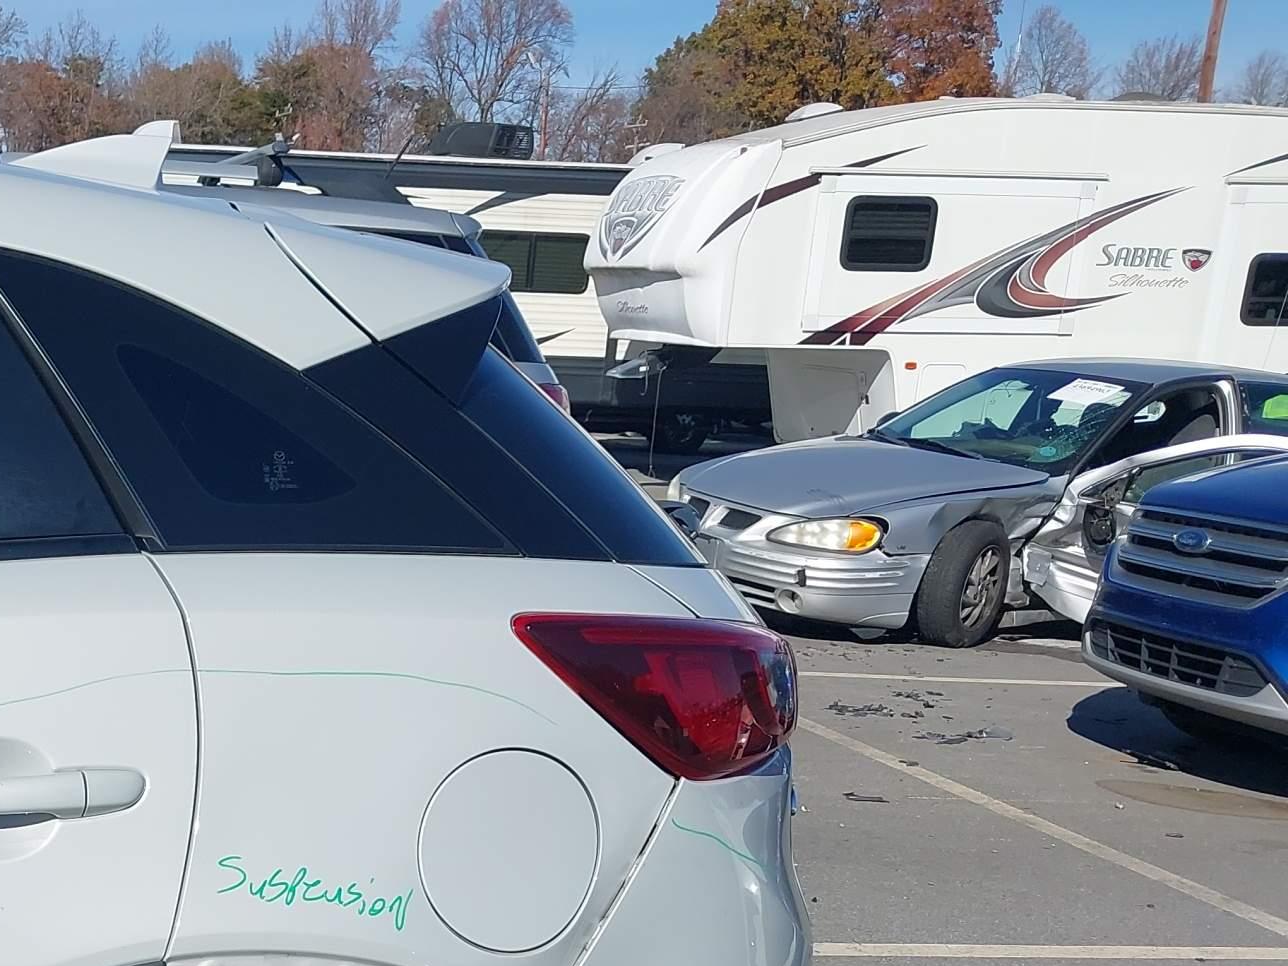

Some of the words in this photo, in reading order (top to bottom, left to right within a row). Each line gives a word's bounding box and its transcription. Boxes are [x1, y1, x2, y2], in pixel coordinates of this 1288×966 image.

[1095, 243, 1178, 269] SABRE
[1108, 273, 1190, 289] Silhouette
[216, 855, 414, 932] Suspension
